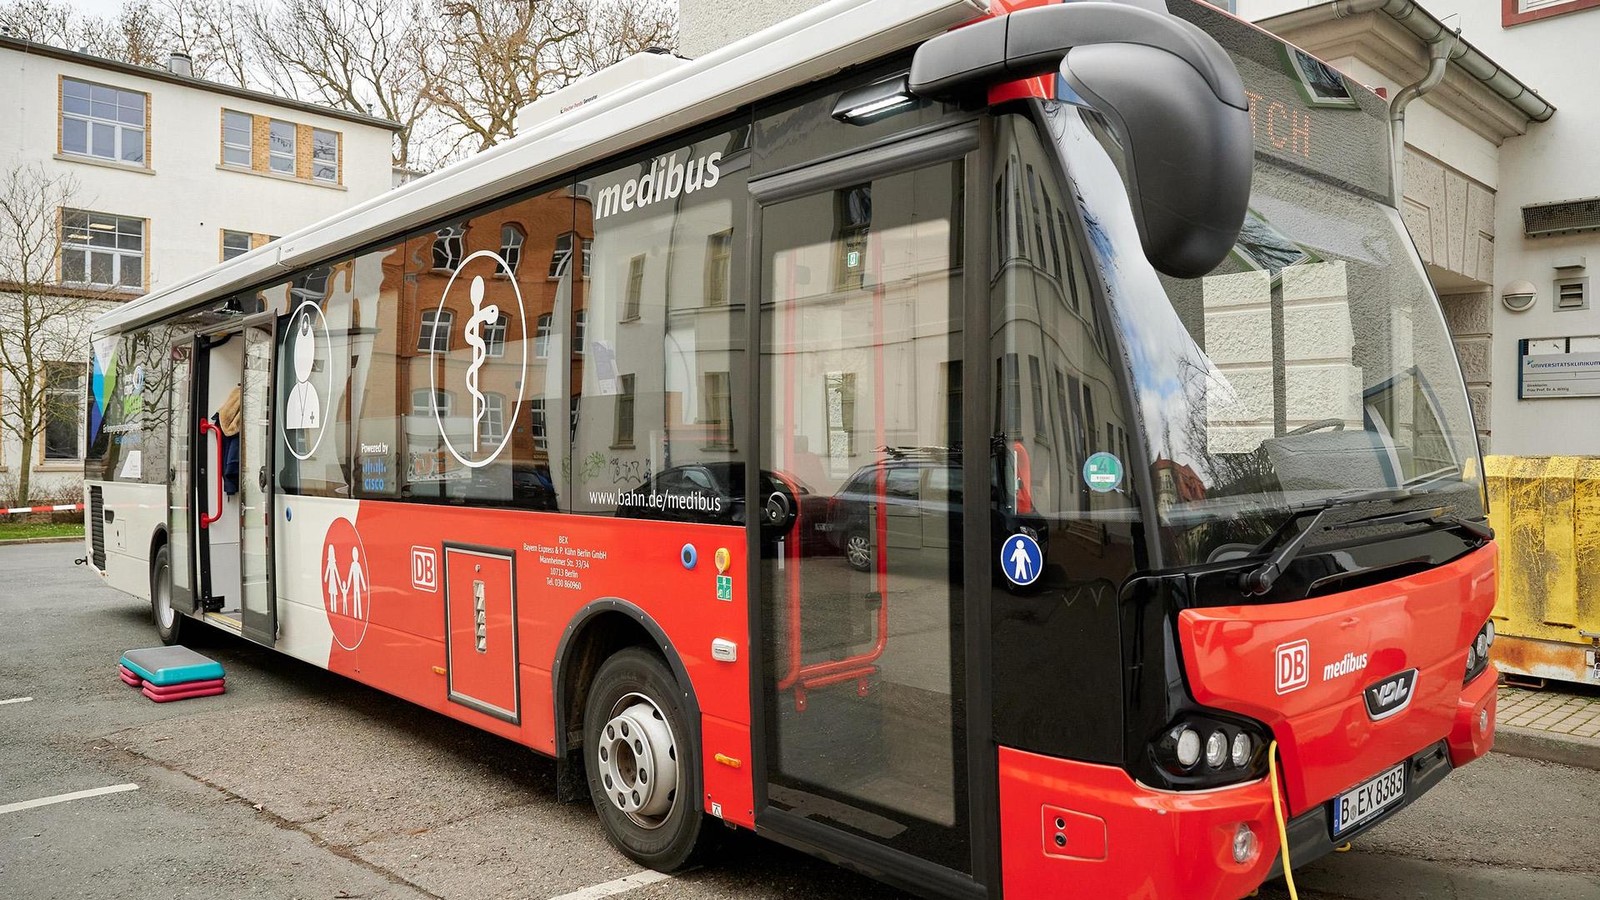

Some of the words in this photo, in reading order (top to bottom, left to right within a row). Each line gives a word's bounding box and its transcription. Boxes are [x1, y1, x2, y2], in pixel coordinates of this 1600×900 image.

[596, 152, 722, 220] medibus
[361, 442, 382, 454] Powered
[382, 441, 389, 455] by
[589, 488, 721, 511] www.bahn.de/medibus
[558, 535, 569, 544] BEX
[538, 544, 555, 554] Express
[577, 548, 591, 558] Berlin
[591, 550, 607, 559] GmbH
[540, 554, 566, 566] Mannheimer
[575, 559, 590, 569] 33/34
[414, 552, 434, 586] DB
[550, 567, 564, 577] 10713
[564, 569, 579, 578] Berlin
[546, 576, 554, 586] Tel.
[554, 578, 564, 588] 030
[1280, 647, 1305, 686] DB
[1323, 652, 1368, 681] medibus
[1372, 677, 1408, 708] VDL
[1341, 797, 1350, 825] B
[1357, 785, 1374, 817] EX
[1376, 767, 1403, 806] 8383
